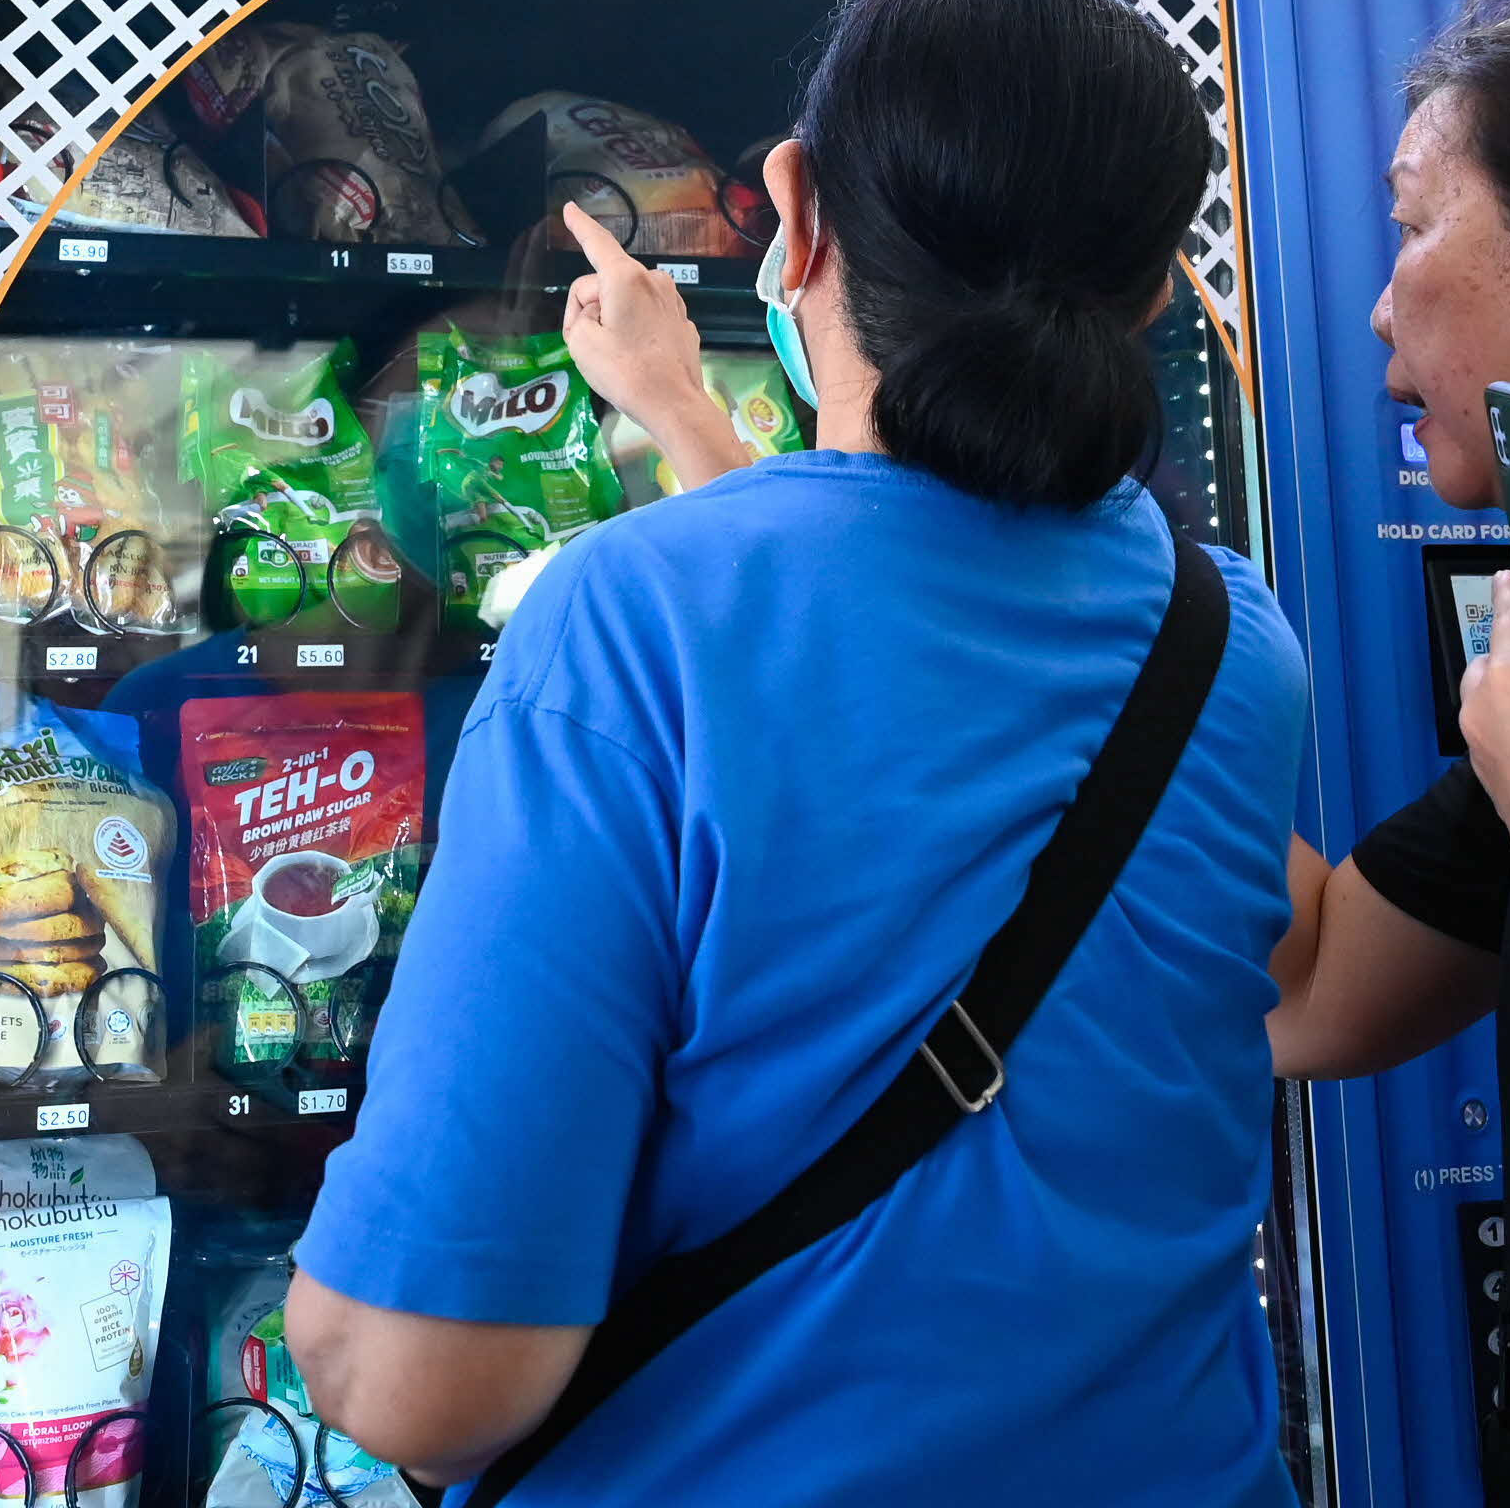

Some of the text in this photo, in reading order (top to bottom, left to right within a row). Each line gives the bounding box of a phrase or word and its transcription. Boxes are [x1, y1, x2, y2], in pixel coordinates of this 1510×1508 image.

[60, 242, 109, 260] $5.90
[330, 249, 350, 268] 11
[388, 255, 434, 273] $5.90
[459, 380, 558, 427] MILO
[1377, 523, 1477, 540] HOLD CARD
[48, 650, 97, 668] $2.80
[237, 645, 258, 664] 21
[298, 648, 343, 665] $5.60
[282, 746, 330, 774] 2-IN-1
[234, 749, 376, 827] TEH-O
[242, 791, 372, 844] BROWN RAW SUGAR
[228, 1095, 250, 1116] 31
[299, 1092, 346, 1112] $1.70
[39, 1109, 88, 1128] $2.50
[1414, 1165, 1495, 1191] (1) PRESS
[9, 1230, 94, 1249] MOISTURE FRESH
[22, 1419, 93, 1438] FLORAL BLOOM
[63, 1432, 83, 1442] BODY
